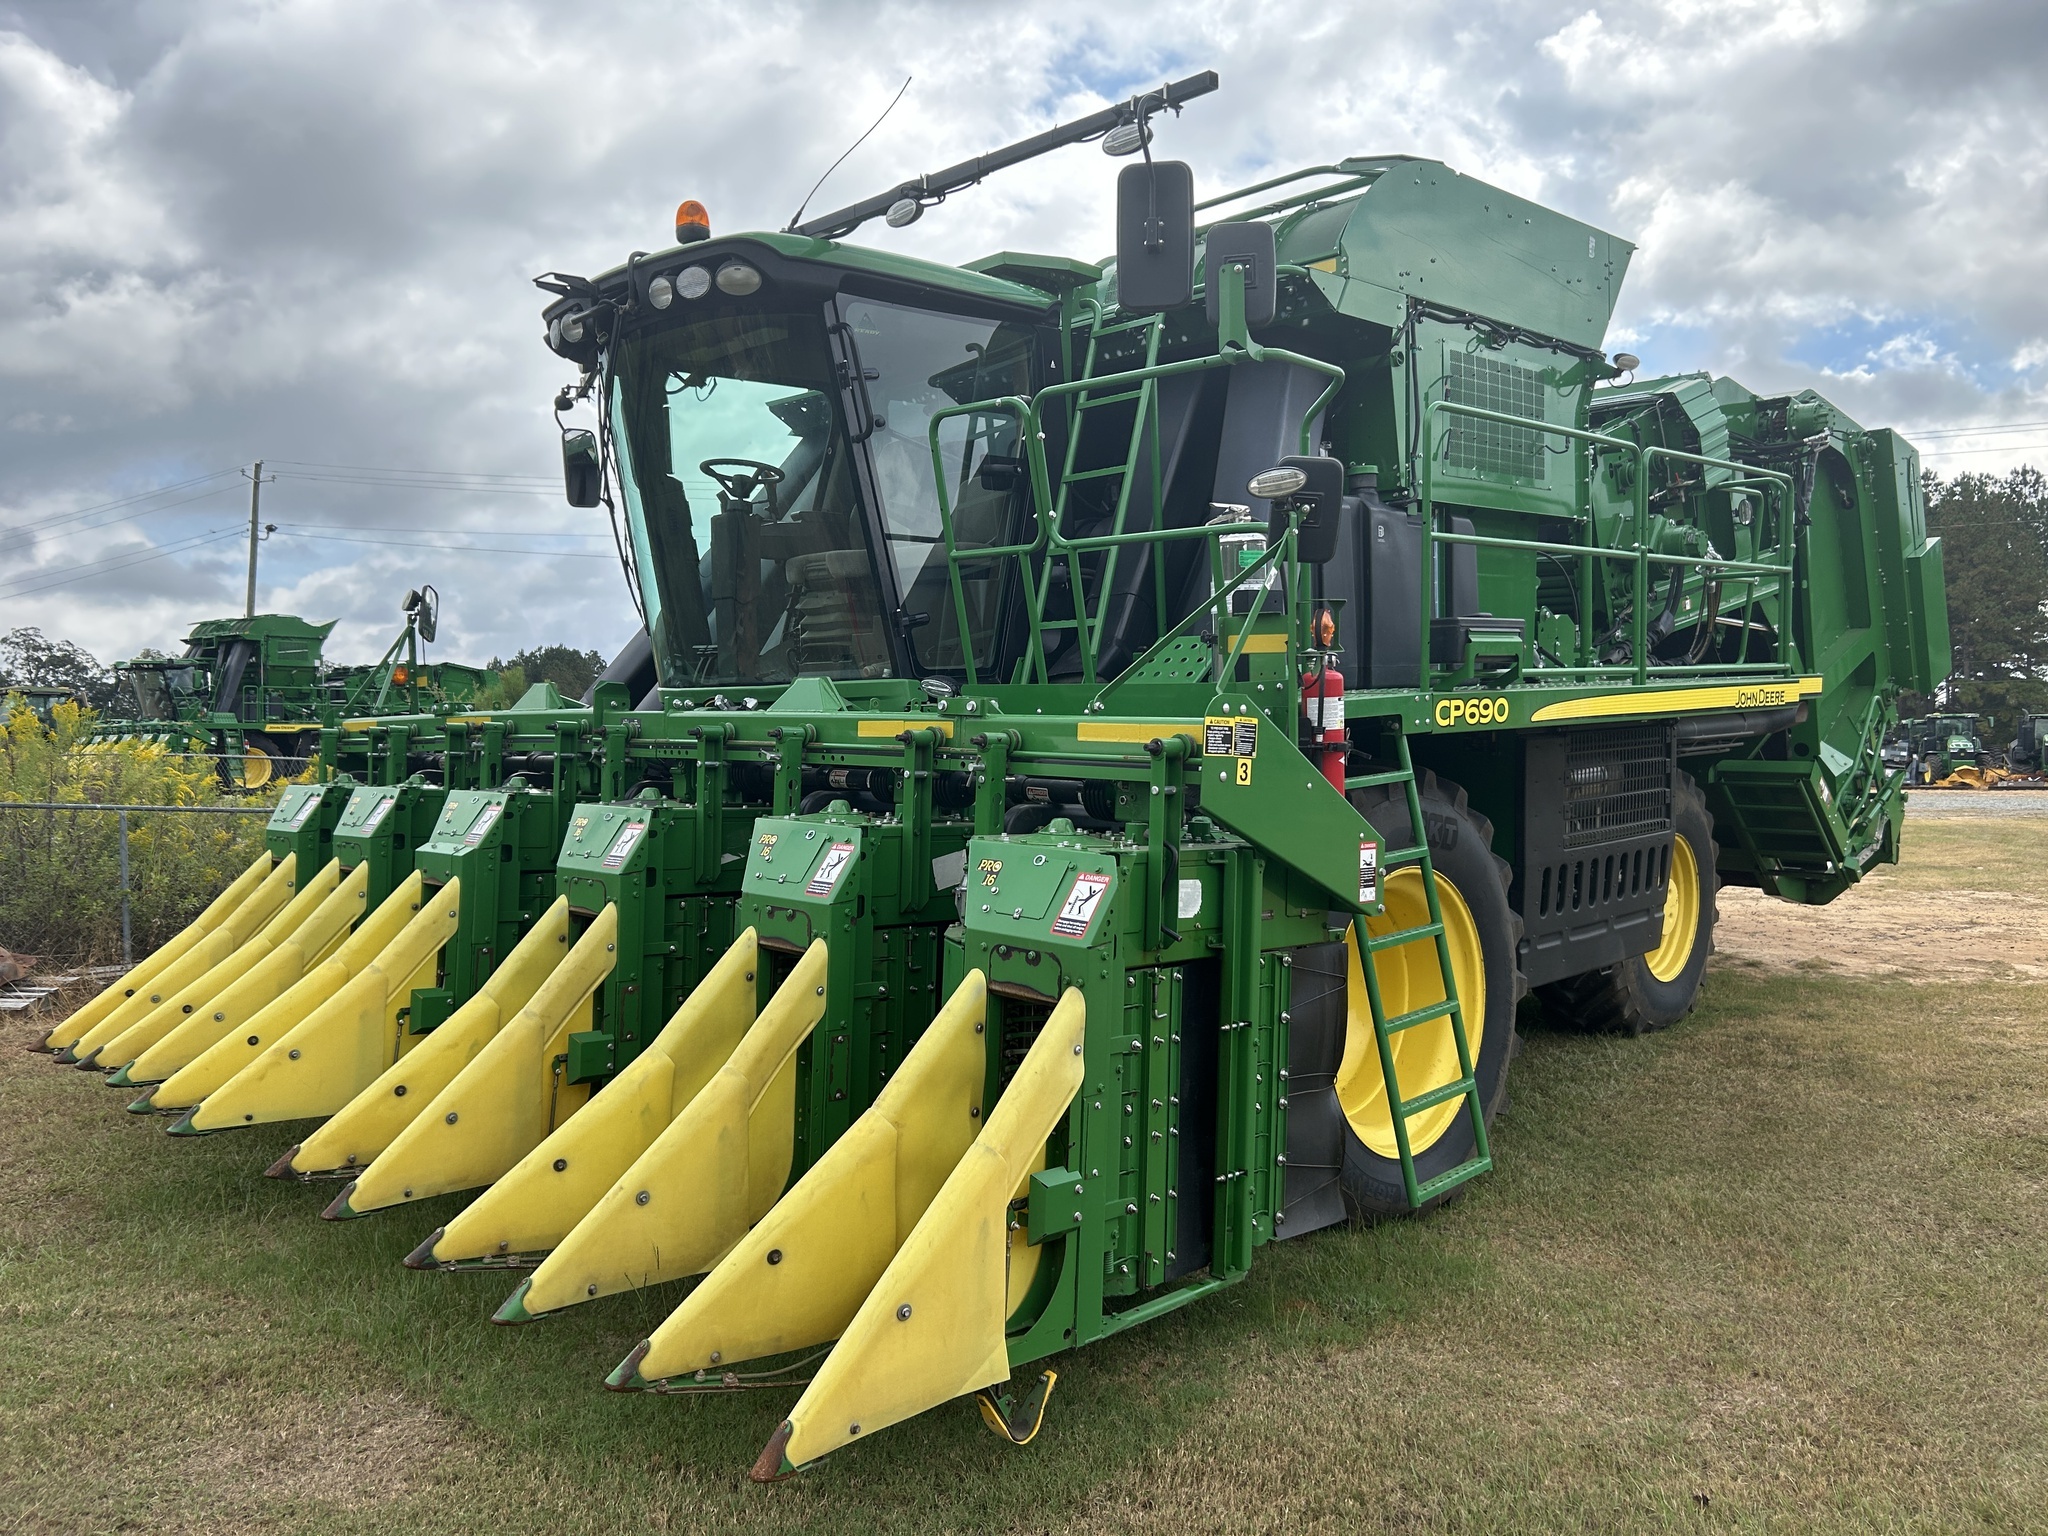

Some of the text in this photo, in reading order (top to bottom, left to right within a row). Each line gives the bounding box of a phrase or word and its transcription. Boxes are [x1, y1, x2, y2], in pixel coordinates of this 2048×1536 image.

[1735, 688, 1785, 708] JOHN DEERE
[1435, 697, 1509, 727] CP690
[1239, 762, 1248, 782] 3
[758, 834, 778, 845] PRO
[760, 846, 772, 857] 16
[836, 843, 855, 852] DANGER
[977, 858, 1003, 873] PRO
[981, 873, 997, 886] 16
[1084, 874, 1110, 883] DANGER
